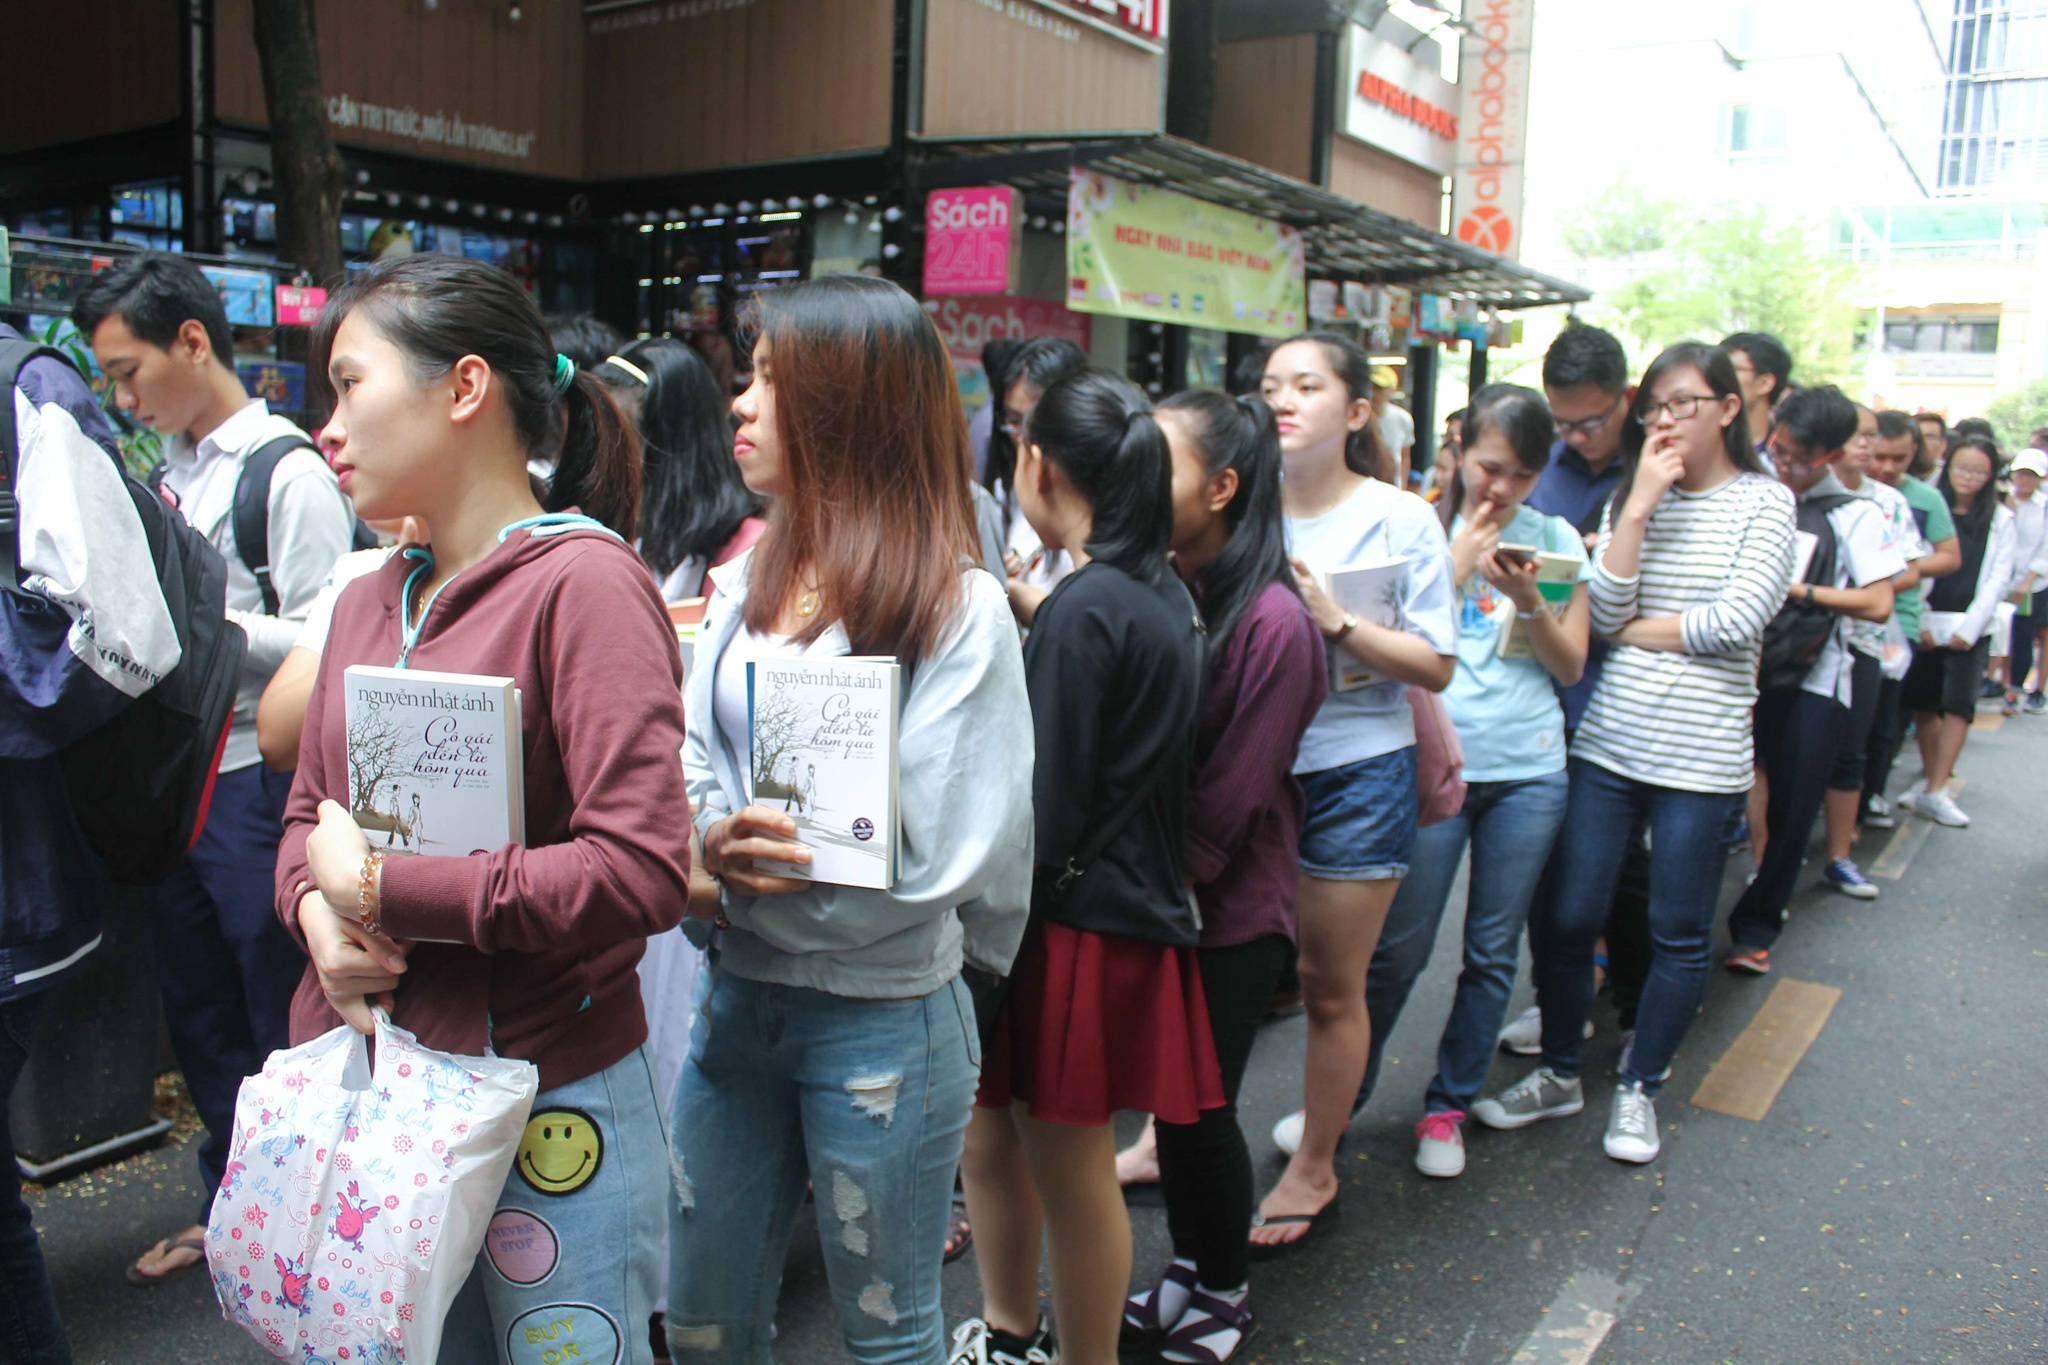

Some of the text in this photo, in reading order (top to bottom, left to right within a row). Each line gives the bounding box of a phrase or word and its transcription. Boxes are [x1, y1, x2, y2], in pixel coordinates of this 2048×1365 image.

[931, 195, 1008, 229] Sách
[926, 232, 1006, 279] 24h
[766, 669, 883, 690] nguyễn nhật ánh
[358, 688, 494, 712] nguyễn nhật ánh
[821, 692, 881, 731] Cô gái
[425, 715, 495, 757] Cô gái
[427, 738, 460, 762] đến
[810, 725, 842, 747] hôm
[844, 740, 875, 760] qua
[413, 750, 453, 775] hôm
[453, 767, 491, 789] qua
[396, 1107, 433, 1137] Lucky
[363, 1157, 396, 1185] Lucky
[251, 1176, 284, 1208] Lucky
[491, 1222, 537, 1239] NEVER
[500, 1238, 534, 1253] STOP
[340, 1279, 372, 1309] Lucky
[523, 1315, 574, 1345] BUY
[541, 1342, 582, 1365] OR
